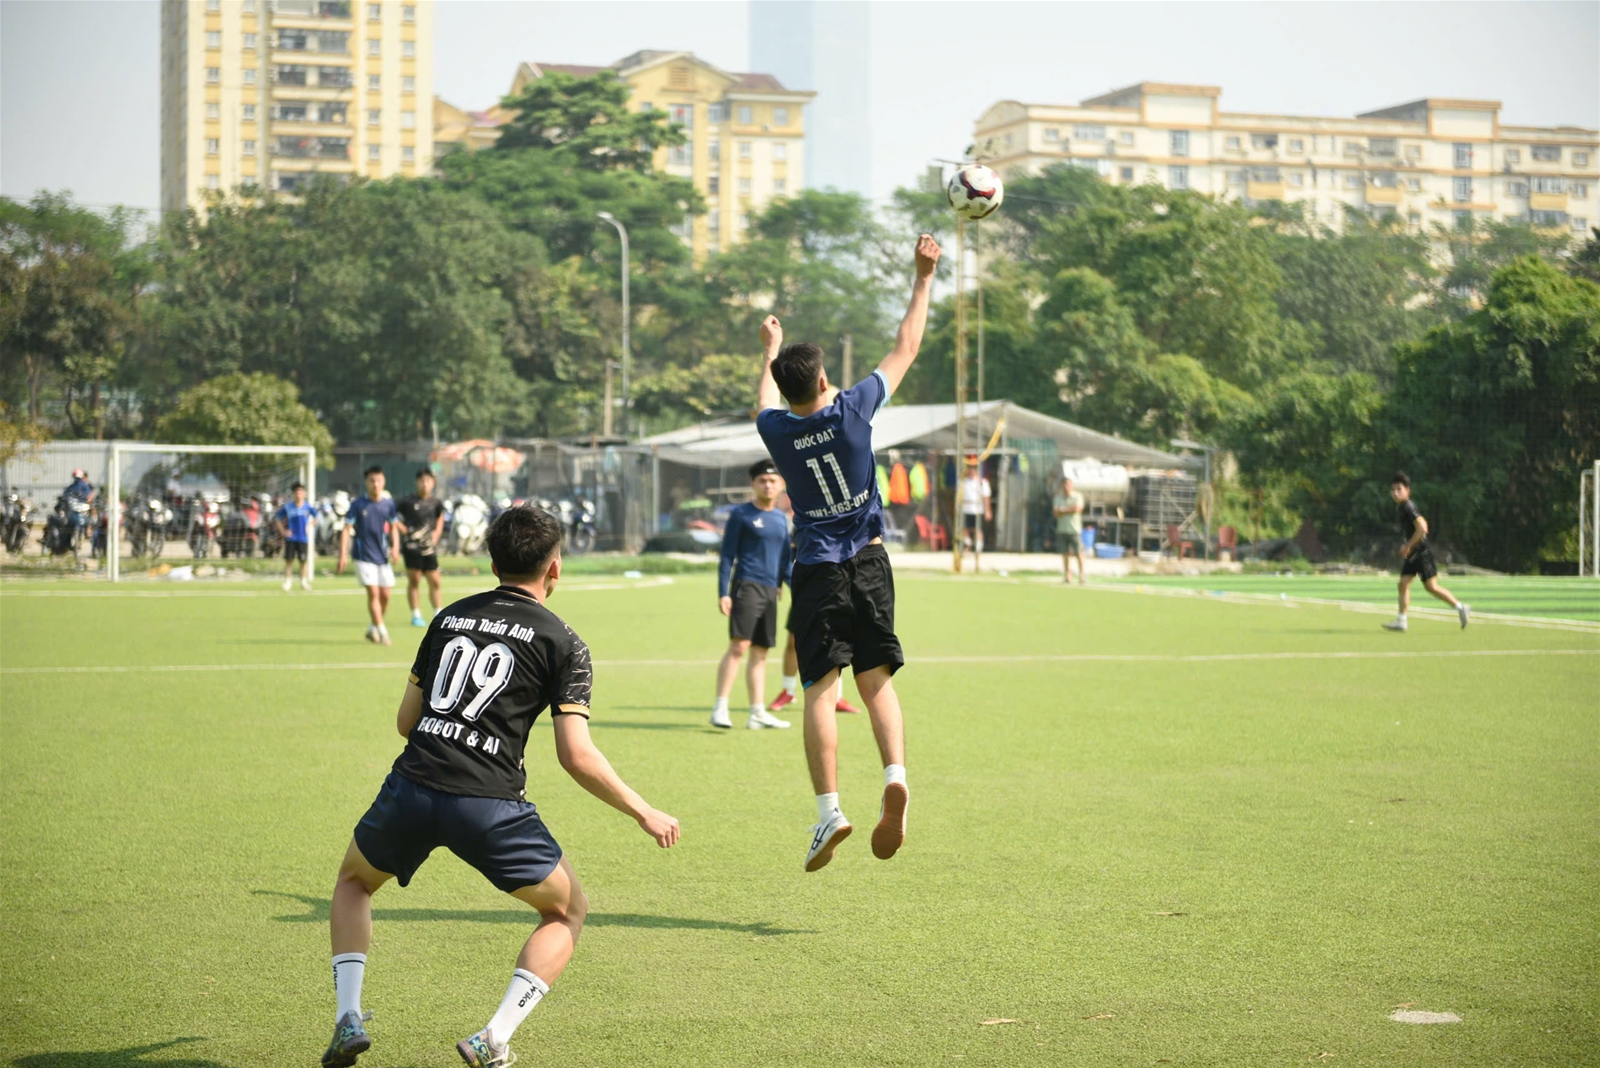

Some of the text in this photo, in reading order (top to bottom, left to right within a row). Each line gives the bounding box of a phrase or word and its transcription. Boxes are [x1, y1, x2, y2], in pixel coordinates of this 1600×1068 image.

[793, 428, 835, 450] QUỐC ĐẠT
[805, 452, 852, 506] 11
[440, 615, 536, 643] Phạm Tuấn Anh
[429, 635, 515, 721] 09
[466, 731, 480, 747] &
[482, 736, 500, 756] AI
